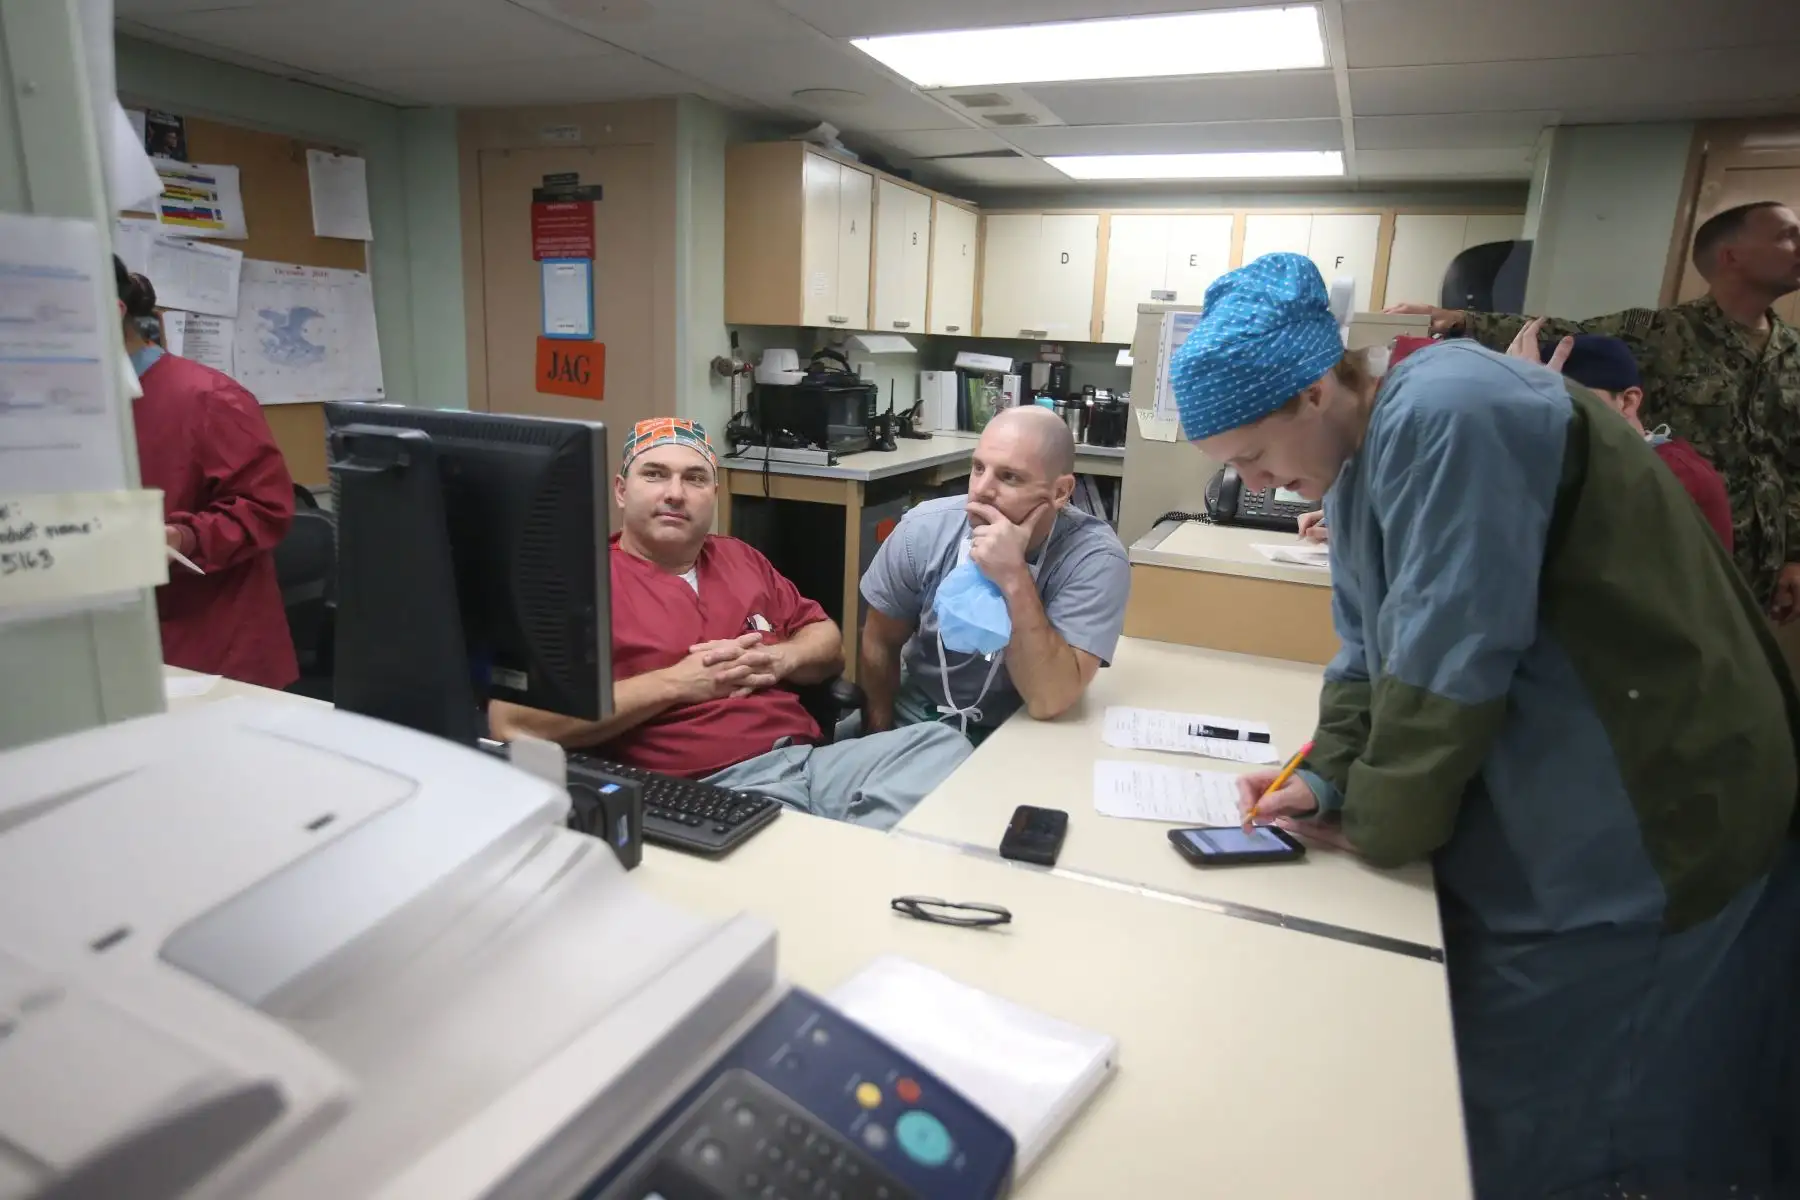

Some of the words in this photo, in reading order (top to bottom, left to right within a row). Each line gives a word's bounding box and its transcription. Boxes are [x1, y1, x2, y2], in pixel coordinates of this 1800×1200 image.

[1060, 252, 1070, 264] D
[1189, 254, 1198, 267] E
[1334, 256, 1345, 270] F
[546, 350, 591, 387] JAG
[1, 547, 55, 575] 5163
